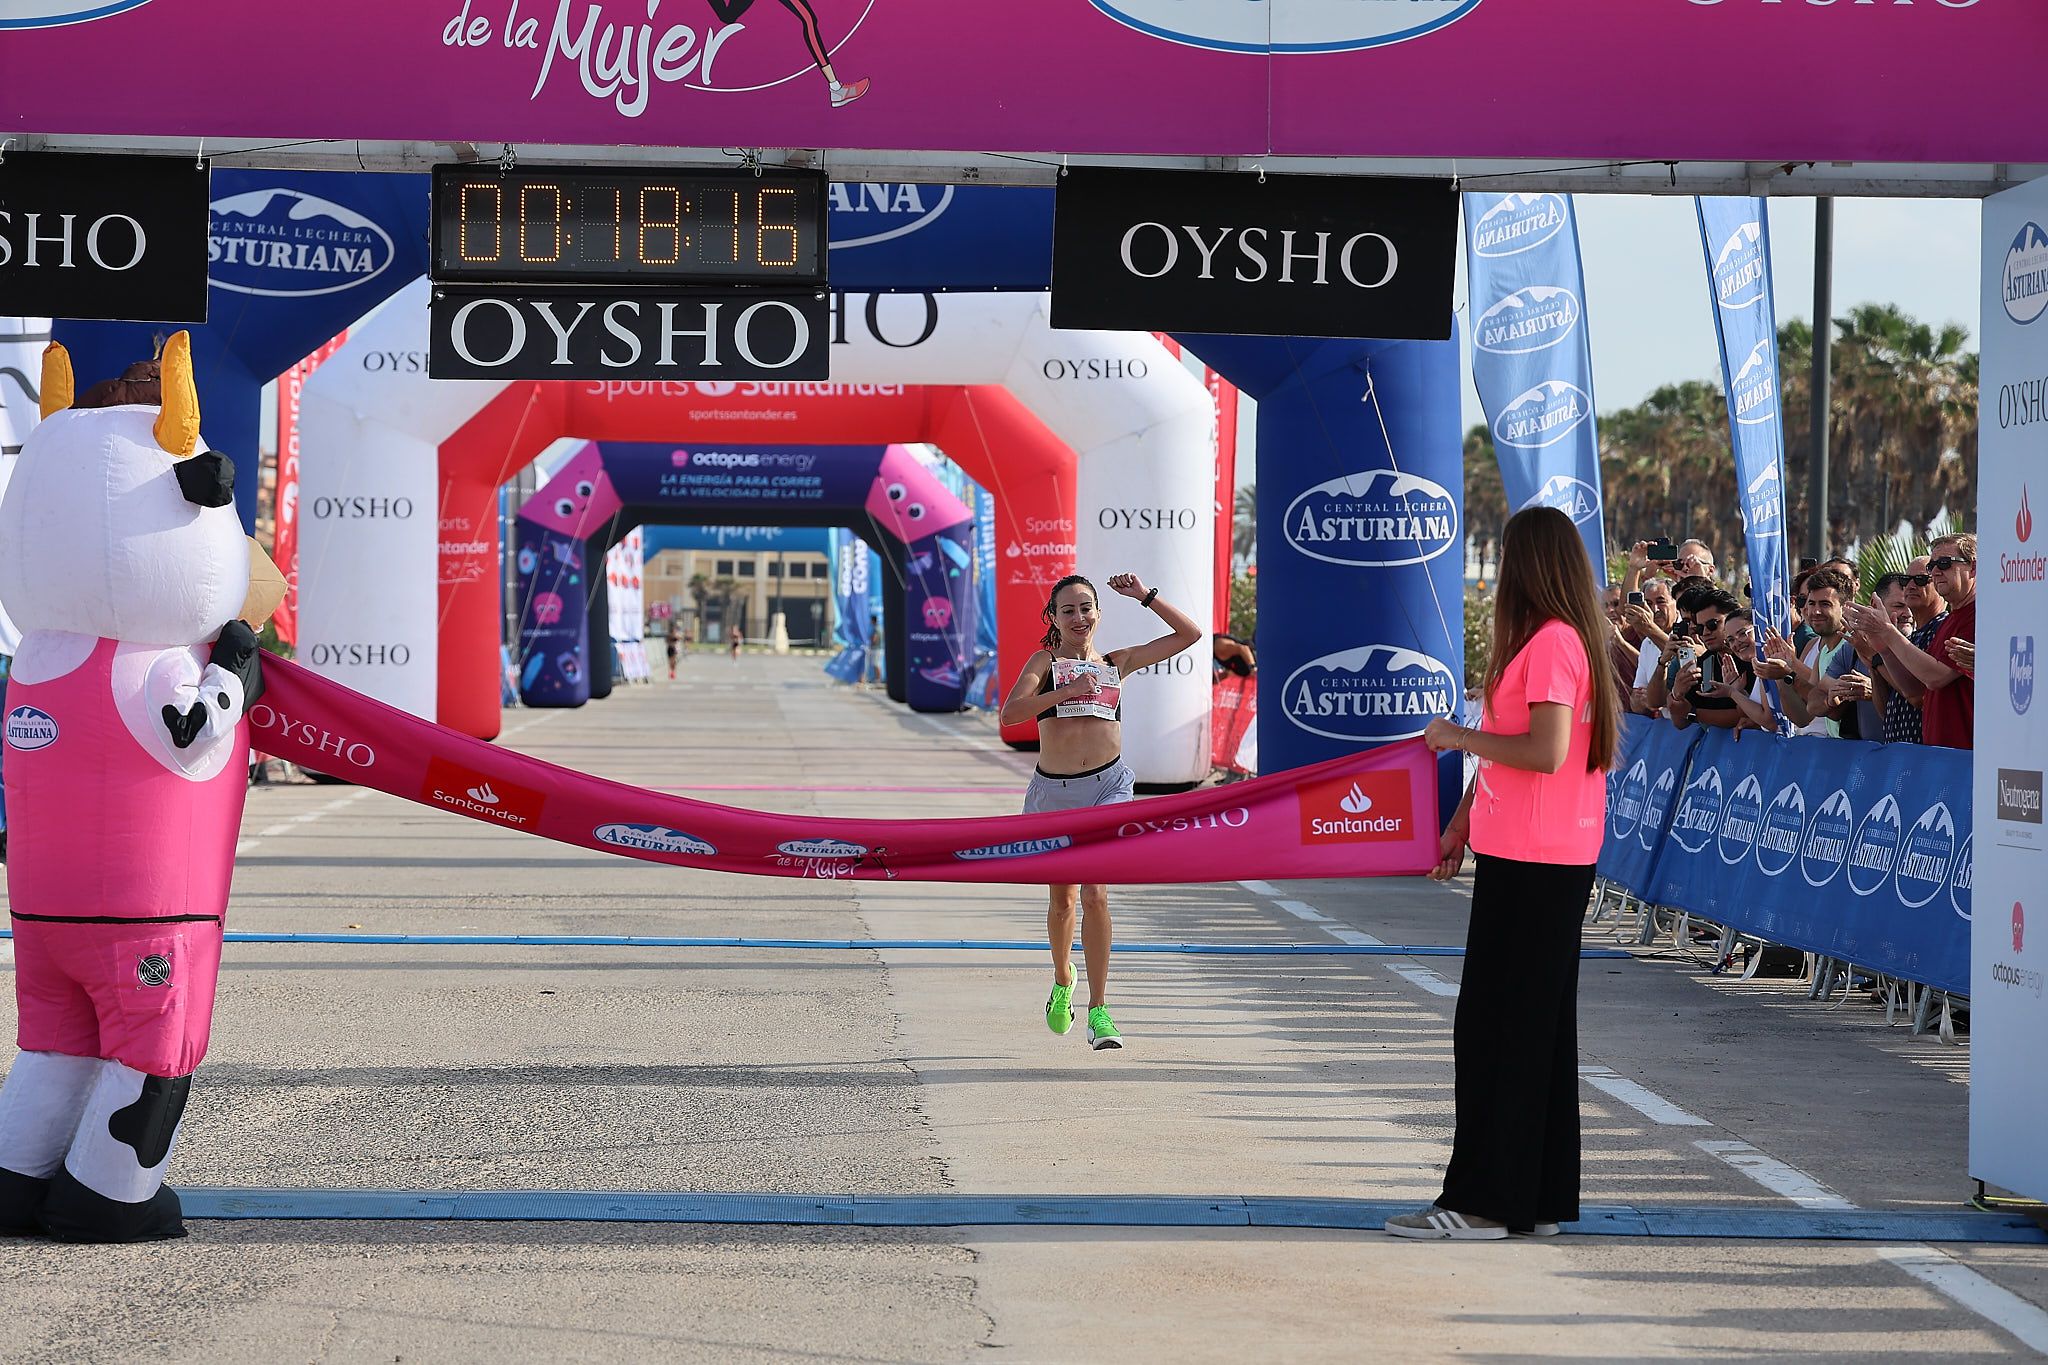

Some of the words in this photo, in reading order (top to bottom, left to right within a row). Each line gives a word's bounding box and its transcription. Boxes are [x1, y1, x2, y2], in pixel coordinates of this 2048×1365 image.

[442, 0, 493, 47] de
[503, 0, 539, 48] la
[530, 0, 745, 117] Mujer
[210, 222, 286, 236] CENTRAL
[295, 227, 372, 243] LECHERA
[208, 236, 374, 273] STURIANA
[1120, 221, 1399, 288] OYSHO
[2006, 264, 2048, 302] ASTURIAN
[451, 299, 810, 369] OYSHO
[363, 351, 429, 373] OYS
[1043, 359, 1148, 380] OYSHO
[689, 409, 798, 420] sportssantander.es
[661, 474, 677, 485] LA
[735, 475, 769, 486] PARA
[313, 496, 413, 519] OYSHO
[1099, 507, 1196, 530] OYSHO
[1324, 502, 1389, 513] CENTRAL
[1395, 501, 1448, 512] LECHERA
[1025, 516, 1072, 534] Sports
[1295, 505, 1451, 541] ASTURIANA
[2000, 551, 2046, 584] Santander
[311, 643, 410, 665] OYSHO
[1321, 678, 1387, 688] CENTRAL
[1392, 676, 1446, 687] LECHERA
[1293, 680, 1449, 716] ASTURIANA
[249, 704, 375, 767] OYSHO
[433, 789, 527, 825] Santander
[2000, 779, 2039, 816] Neutrogena
[1117, 807, 1249, 838] OYSHO
[1312, 816, 1402, 835] Santander
[783, 843, 860, 855] ASTURIANA
[803, 858, 862, 879] Mujer
